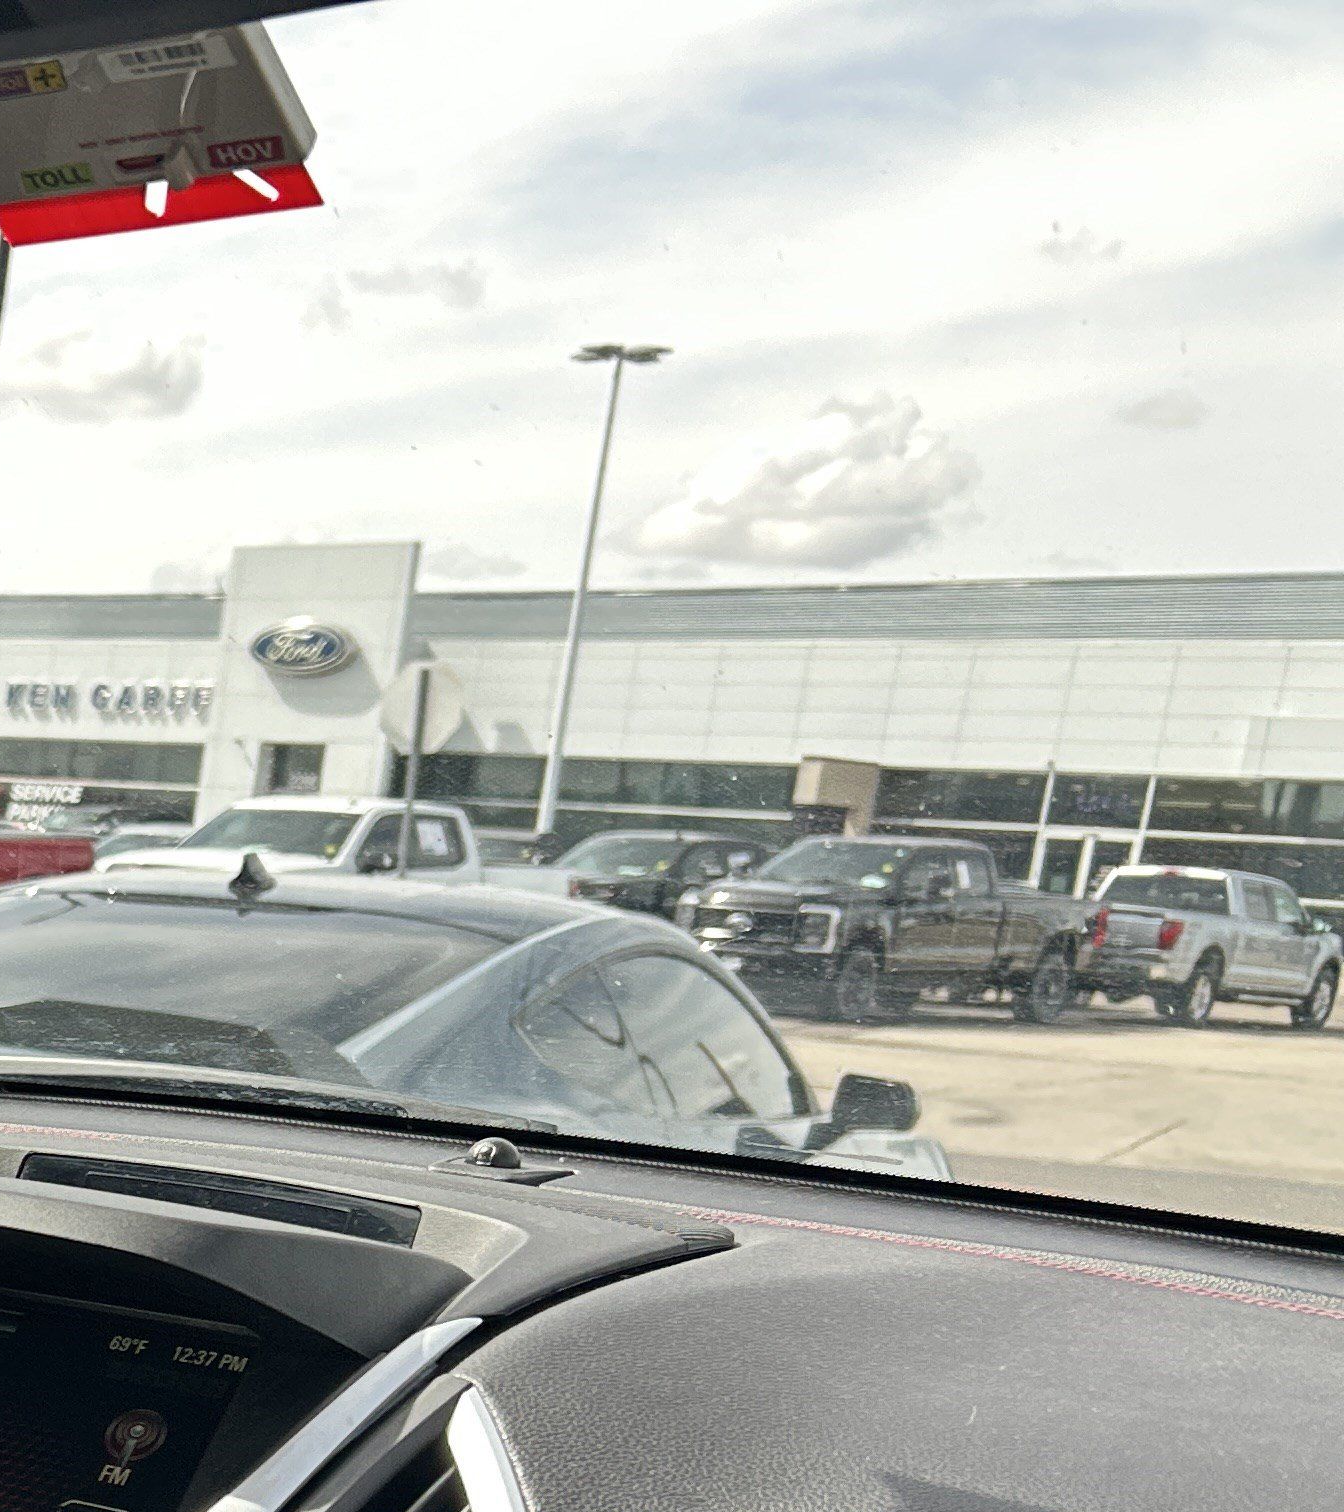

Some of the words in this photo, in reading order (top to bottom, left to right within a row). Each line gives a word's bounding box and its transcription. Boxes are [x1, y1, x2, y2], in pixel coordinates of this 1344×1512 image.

[215, 143, 273, 165] HOV
[26, 167, 91, 189] TOLL
[266, 632, 328, 663] Ford
[7, 681, 79, 712] KEN
[9, 784, 84, 803] SERVICE
[109, 1335, 150, 1355] 69°F
[172, 1346, 218, 1367] 12:37
[218, 1353, 249, 1373] PM
[97, 1464, 133, 1486] FM
